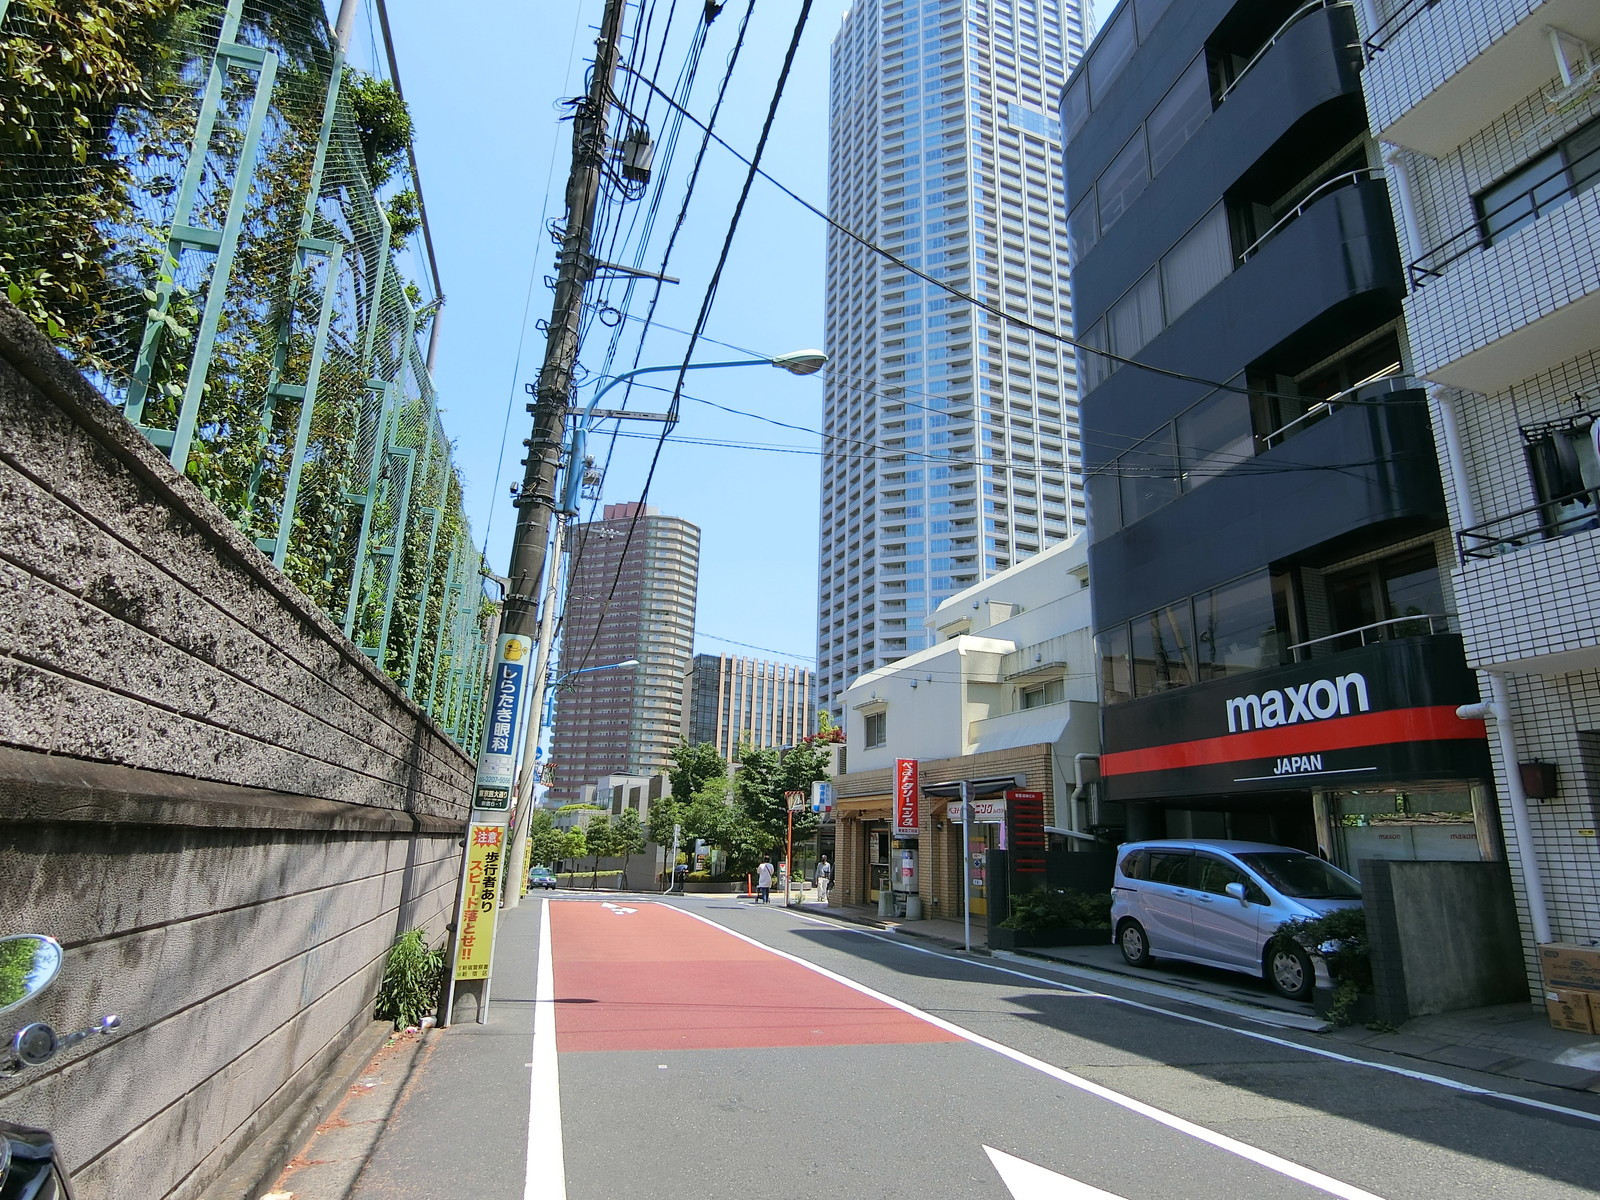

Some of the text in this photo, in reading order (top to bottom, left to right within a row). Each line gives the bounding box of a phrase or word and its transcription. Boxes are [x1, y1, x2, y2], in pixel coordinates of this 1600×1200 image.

[491, 665, 517, 753] しらたき眼科
[1226, 672, 1369, 733] maxon
[1273, 754, 1322, 775] JAPAN
[477, 832, 498, 844] 注意
[481, 851, 499, 913] 歩行者あり
